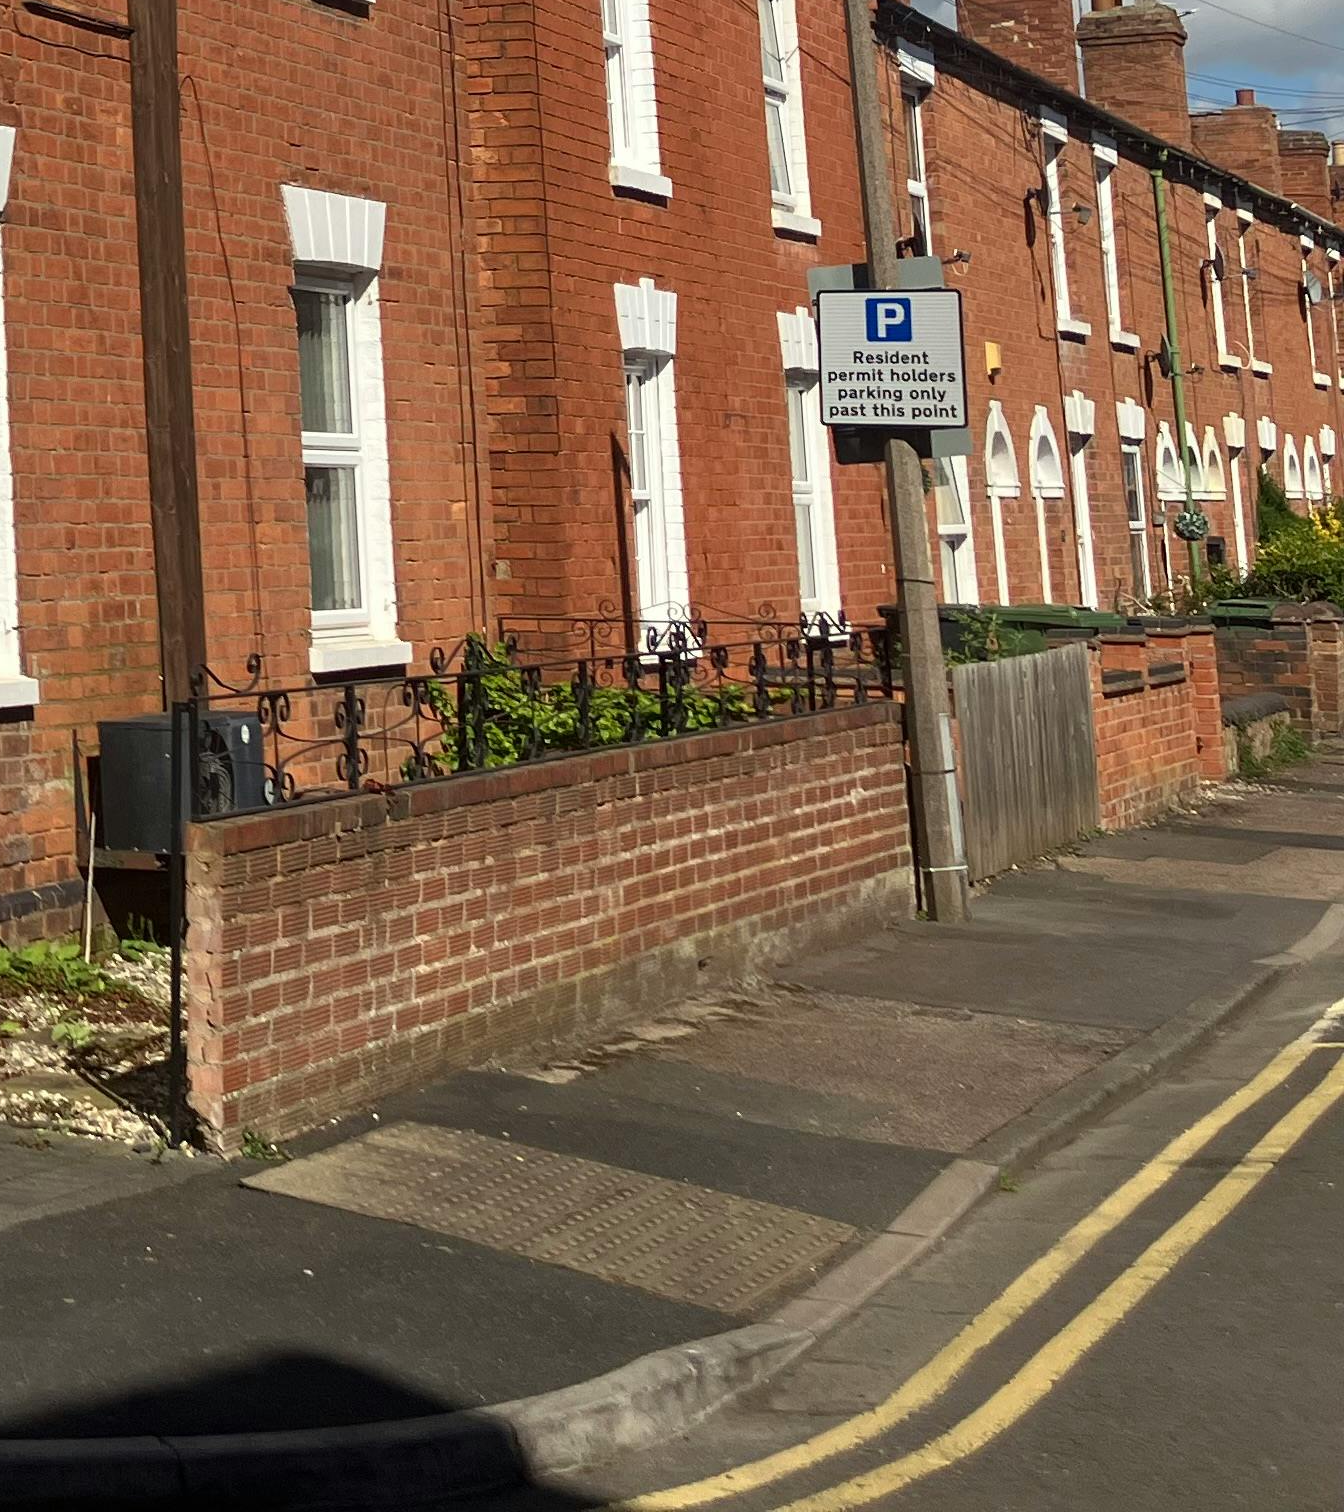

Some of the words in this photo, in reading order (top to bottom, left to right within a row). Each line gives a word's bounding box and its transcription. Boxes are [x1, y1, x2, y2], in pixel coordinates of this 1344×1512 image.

[876, 303, 905, 338] P
[853, 351, 929, 365] Resident
[828, 369, 884, 384] permit
[890, 369, 956, 383] holders
[838, 386, 903, 402] parking
[909, 387, 947, 402] only
[829, 404, 867, 419] past
[873, 404, 905, 418] this
[912, 404, 958, 420] point
